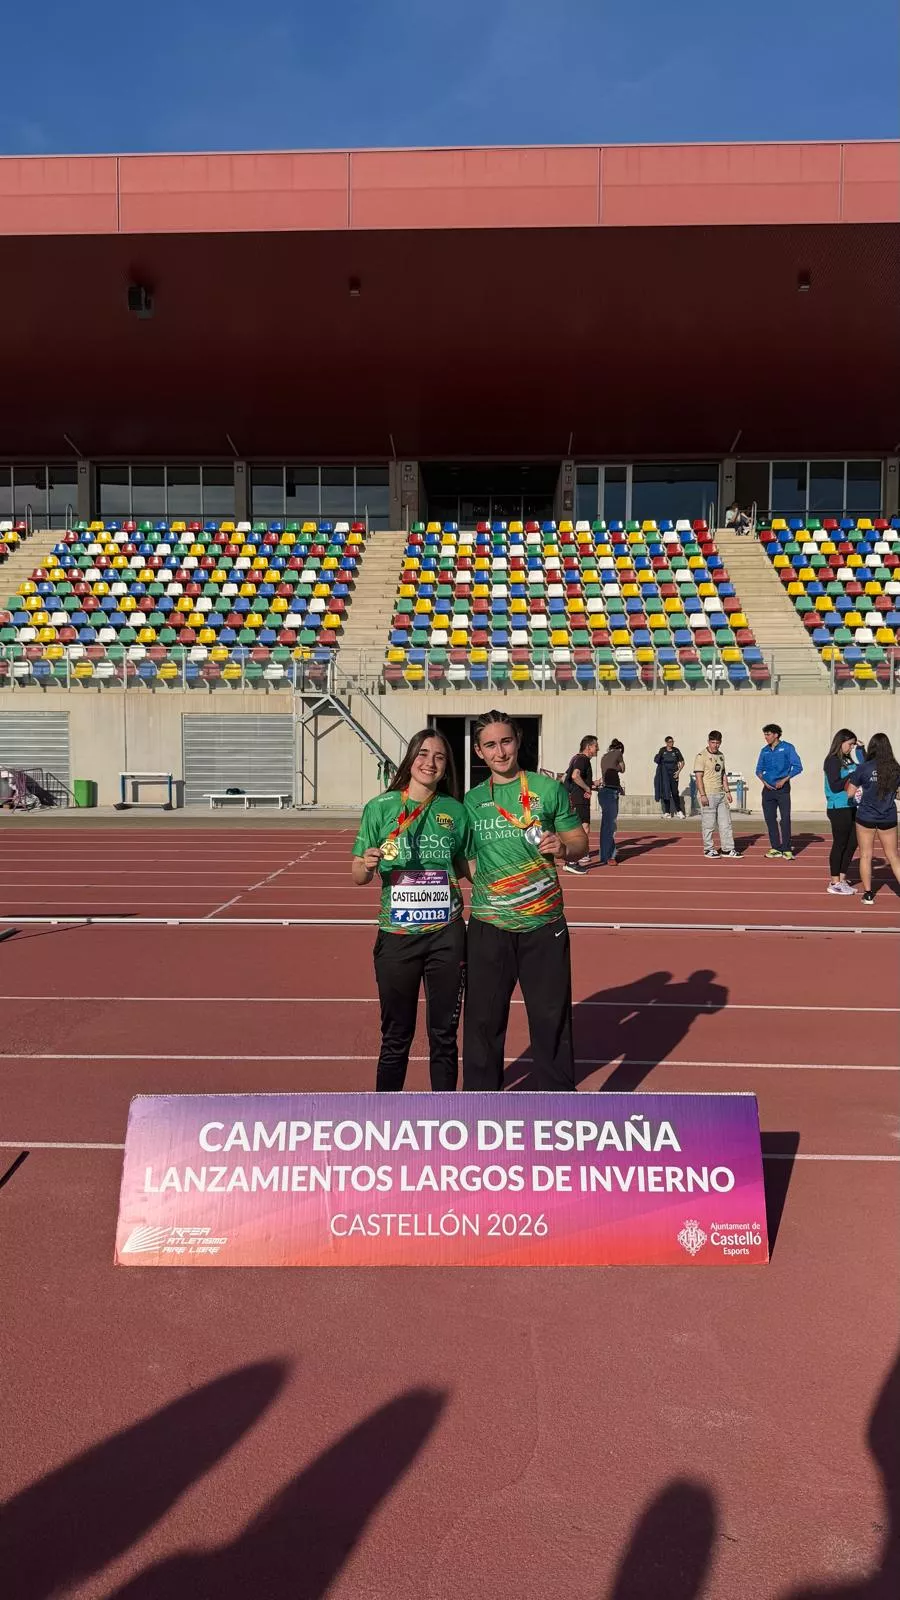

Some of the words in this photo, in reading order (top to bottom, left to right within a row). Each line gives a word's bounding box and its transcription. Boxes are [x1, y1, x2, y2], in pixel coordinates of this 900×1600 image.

[392, 890, 432, 902] CASTELLÓN
[432, 892, 449, 902] 2026
[199, 1120, 469, 1152] CAMPEONATO
[477, 1120, 525, 1151] DE
[534, 1114, 682, 1152] ESPAÑA
[144, 1165, 393, 1193] LANZAMIENTOS
[400, 1165, 525, 1192] LARGOS
[532, 1165, 572, 1192] DE
[580, 1166, 735, 1193] INVIERNO
[330, 1209, 480, 1237] CASTELLÓN
[487, 1213, 549, 1237] 2026
[710, 1222, 750, 1232] Ajuntament
[751, 1221, 760, 1230] de
[167, 1237, 228, 1245] ATLETISMO
[710, 1231, 762, 1246] Castelló
[723, 1247, 749, 1256] Esports
